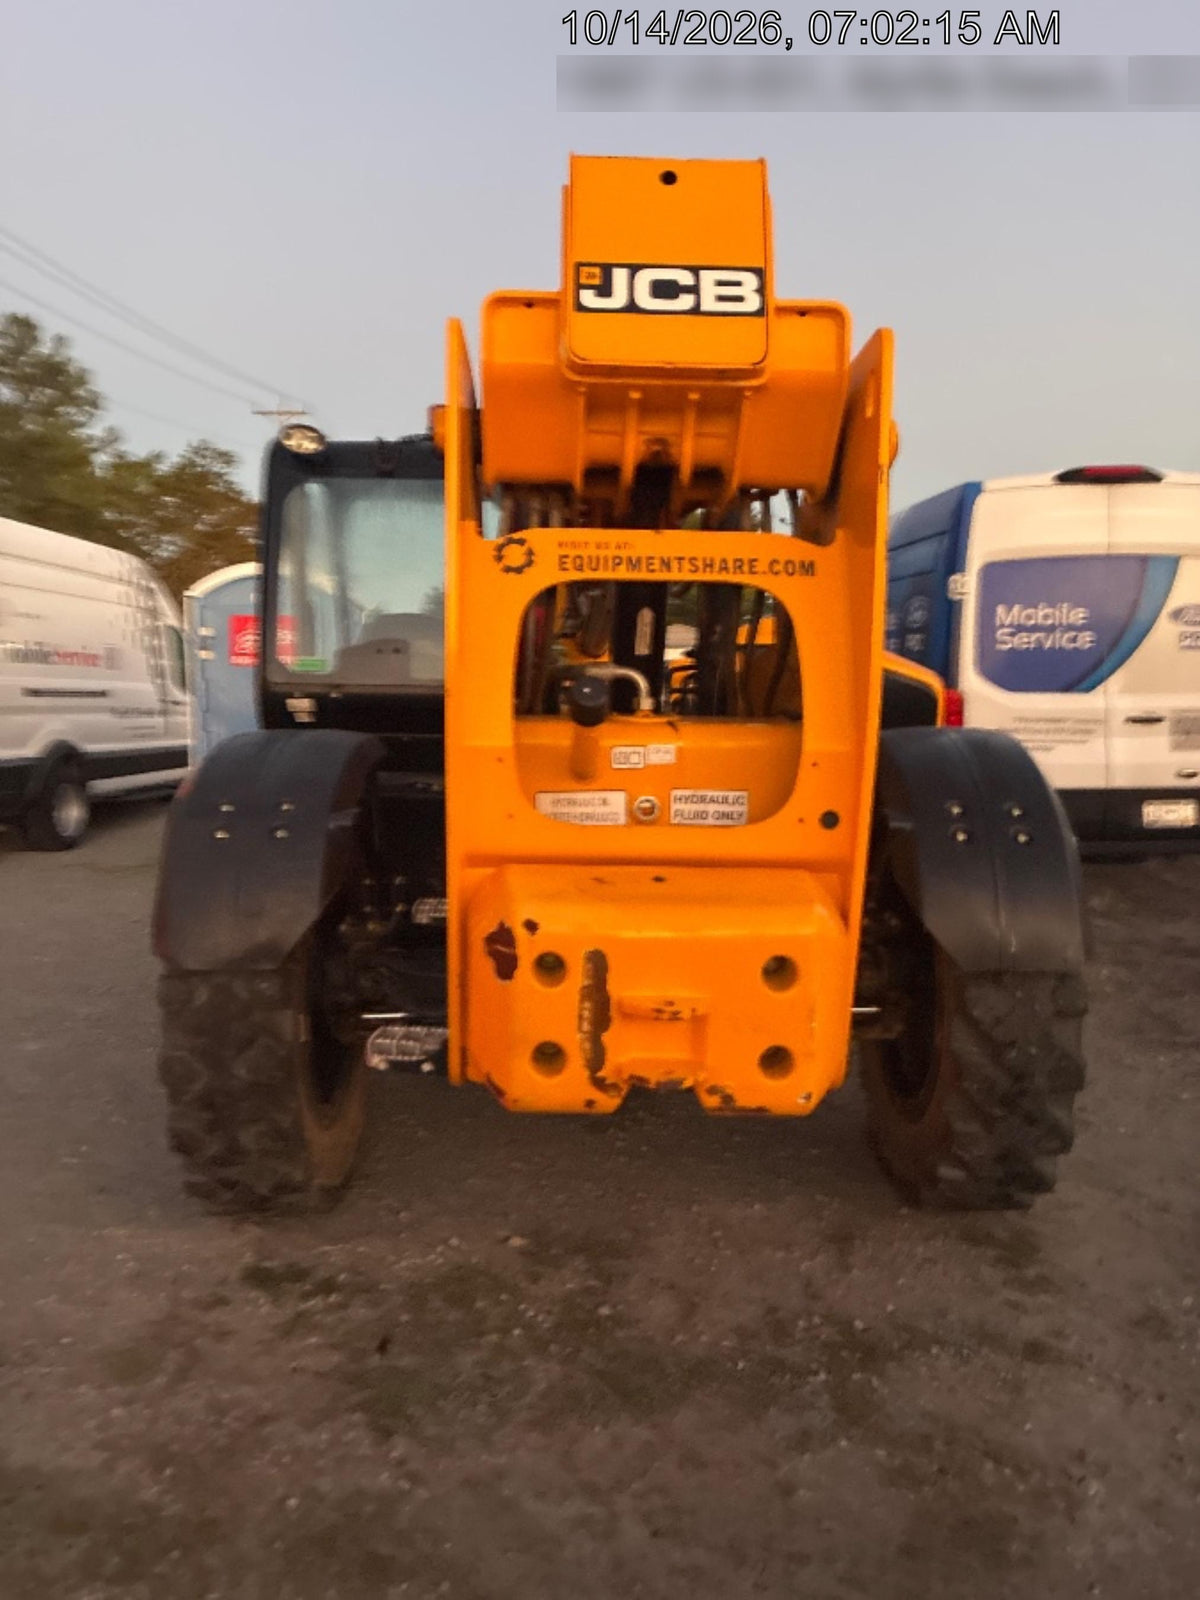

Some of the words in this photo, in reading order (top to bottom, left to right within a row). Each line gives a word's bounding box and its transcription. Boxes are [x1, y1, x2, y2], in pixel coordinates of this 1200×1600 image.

[578, 266, 762, 313] JCB
[558, 553, 816, 577] EQUIPMENTSHARE.COM
[995, 602, 1090, 627] Mobile
[995, 627, 1097, 651] Service
[673, 793, 746, 806] HYDRAULIC
[674, 808, 708, 821] FLUID
[711, 809, 744, 822] ONLY
